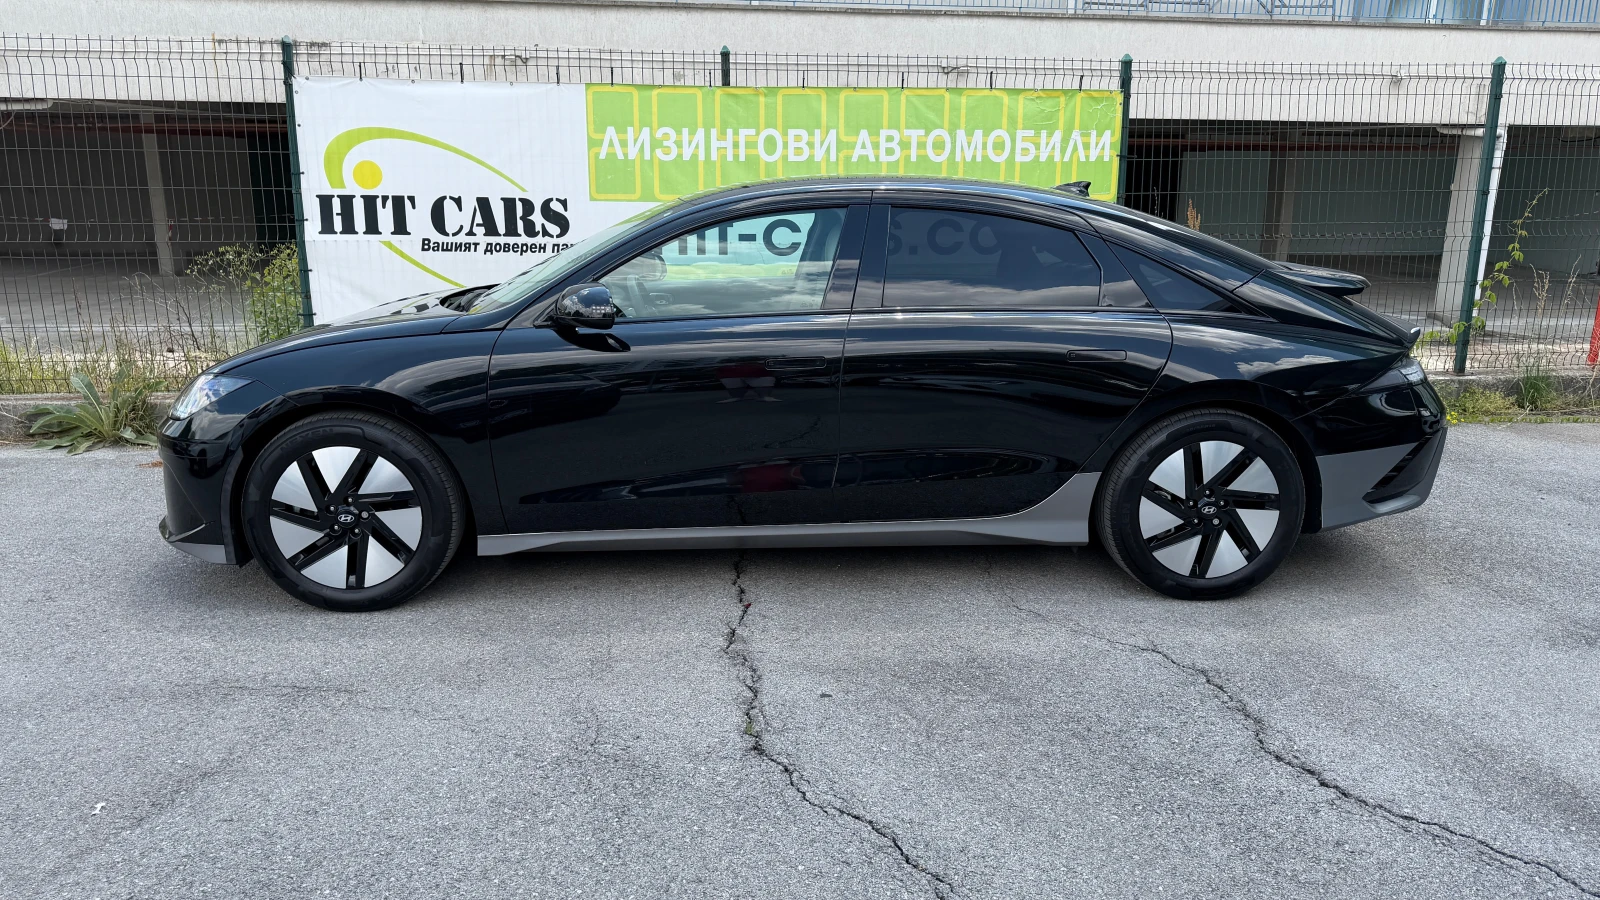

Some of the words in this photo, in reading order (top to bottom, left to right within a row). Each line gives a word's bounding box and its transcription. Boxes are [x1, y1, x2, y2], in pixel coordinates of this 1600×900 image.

[599, 126, 837, 163] ЛИЗИНГОВИ
[851, 128, 1112, 163] АВТОМОБИЛИ
[315, 194, 416, 235] HIT
[430, 195, 571, 239] CARS
[421, 238, 480, 253] Вашият
[484, 241, 547, 256] доверен
